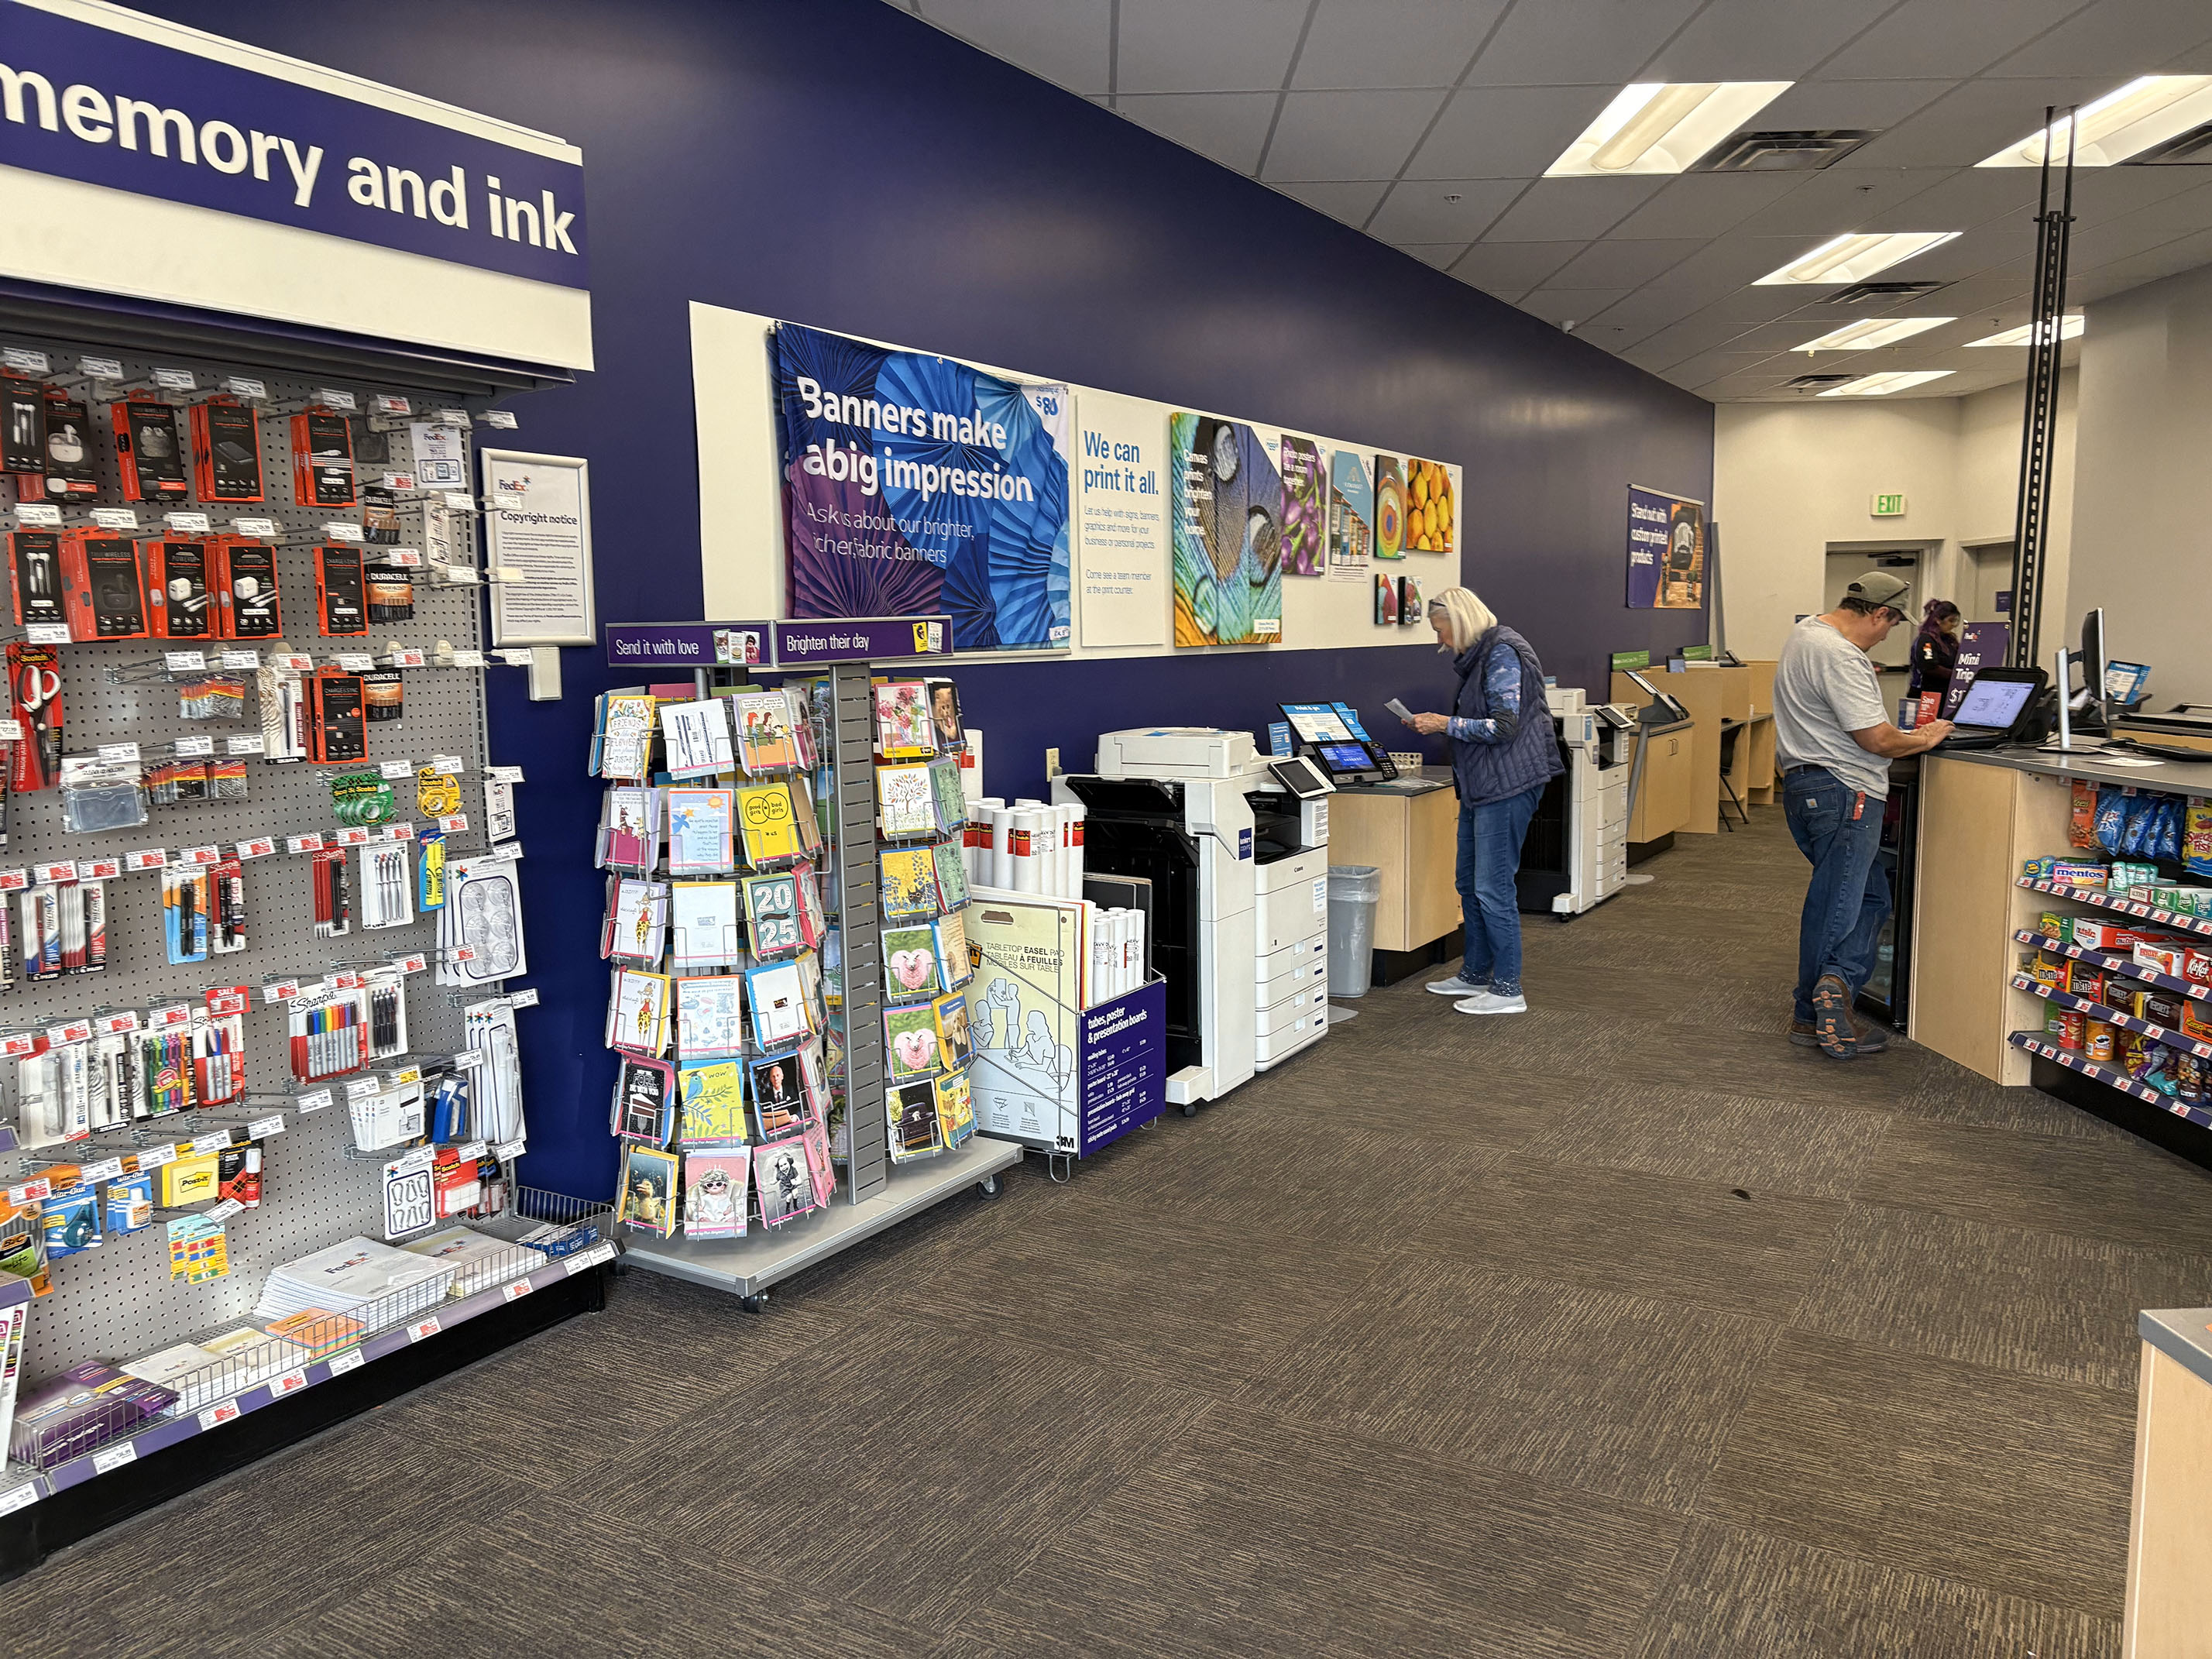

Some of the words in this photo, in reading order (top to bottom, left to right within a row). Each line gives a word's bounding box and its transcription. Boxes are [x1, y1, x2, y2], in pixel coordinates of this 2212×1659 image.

[0, 63, 324, 208] memory
[348, 156, 469, 230] and
[486, 175, 579, 256] ink
[796, 376, 927, 438] Banners
[933, 409, 1007, 449] make
[1084, 430, 1109, 459] We
[1114, 443, 1140, 463] can
[1183, 448, 1208, 464] Canvas
[1298, 452, 1316, 463] posters
[885, 448, 1034, 502] impression
[1084, 464, 1121, 493] print
[1125, 468, 1135, 493] it
[1139, 470, 1159, 495] all.
[1183, 469, 1204, 484] prints
[499, 479, 527, 492] FedEx
[1183, 485, 1213, 502] brighten
[1877, 495, 1902, 514] EXIT
[501, 510, 548, 525] Copyright
[549, 516, 578, 525] notice
[807, 501, 840, 525] Ask
[854, 510, 896, 532] about
[899, 519, 922, 534] our
[924, 510, 975, 541] brighter,
[1184, 507, 1200, 520] your
[1084, 522, 1106, 532] graphics
[1107, 523, 1116, 531] and
[1139, 527, 1149, 535] your
[854, 537, 892, 558] fabric
[895, 541, 947, 563] banners
[1084, 537, 1107, 546] business
[1115, 539, 1135, 549] personal
[370, 572, 409, 581] DURACELL
[1086, 568, 1101, 579] Come
[1132, 572, 1152, 581] member
[616, 639, 640, 655] Send
[643, 637, 650, 655] it
[651, 637, 675, 655] with
[678, 637, 699, 655] love
[786, 634, 828, 654] Brighten
[829, 632, 850, 651] their
[852, 633, 870, 652] day
[1958, 653, 1980, 665] Mini
[1956, 668, 1975, 683] Trip
[356, 785, 377, 794] Scotch
[2056, 869, 2104, 878] mentos
[754, 884, 792, 914] 20
[760, 919, 798, 950] 25
[986, 943, 1022, 953] TABLETOP
[1024, 946, 1048, 956] EASEL
[1049, 949, 1065, 957] PAD
[986, 951, 1018, 962] TABLEAU
[1019, 953, 1025, 962] À
[1027, 957, 1063, 967] FEUILLES
[1020, 962, 1035, 970] SUR
[1036, 964, 1060, 973] TABLE
[218, 988, 236, 996] SALE
[1087, 1015, 1106, 1030] tubes,
[1106, 1007, 1125, 1025] poster
[1087, 1032, 1094, 1044] &
[1093, 1019, 1129, 1044] presentation
[1128, 1009, 1148, 1026] boards
[633, 1073, 657, 1088] FORK
[98, 1123, 128, 1132] ZEBRA
[1056, 1135, 1074, 1149] 3M
[441, 1162, 460, 1173] Scotch
[181, 1176, 208, 1187] Post-it
[2, 1232, 27, 1249] BIC
[427, 1245, 466, 1258] edEx
[324, 1256, 369, 1274] FedEx
